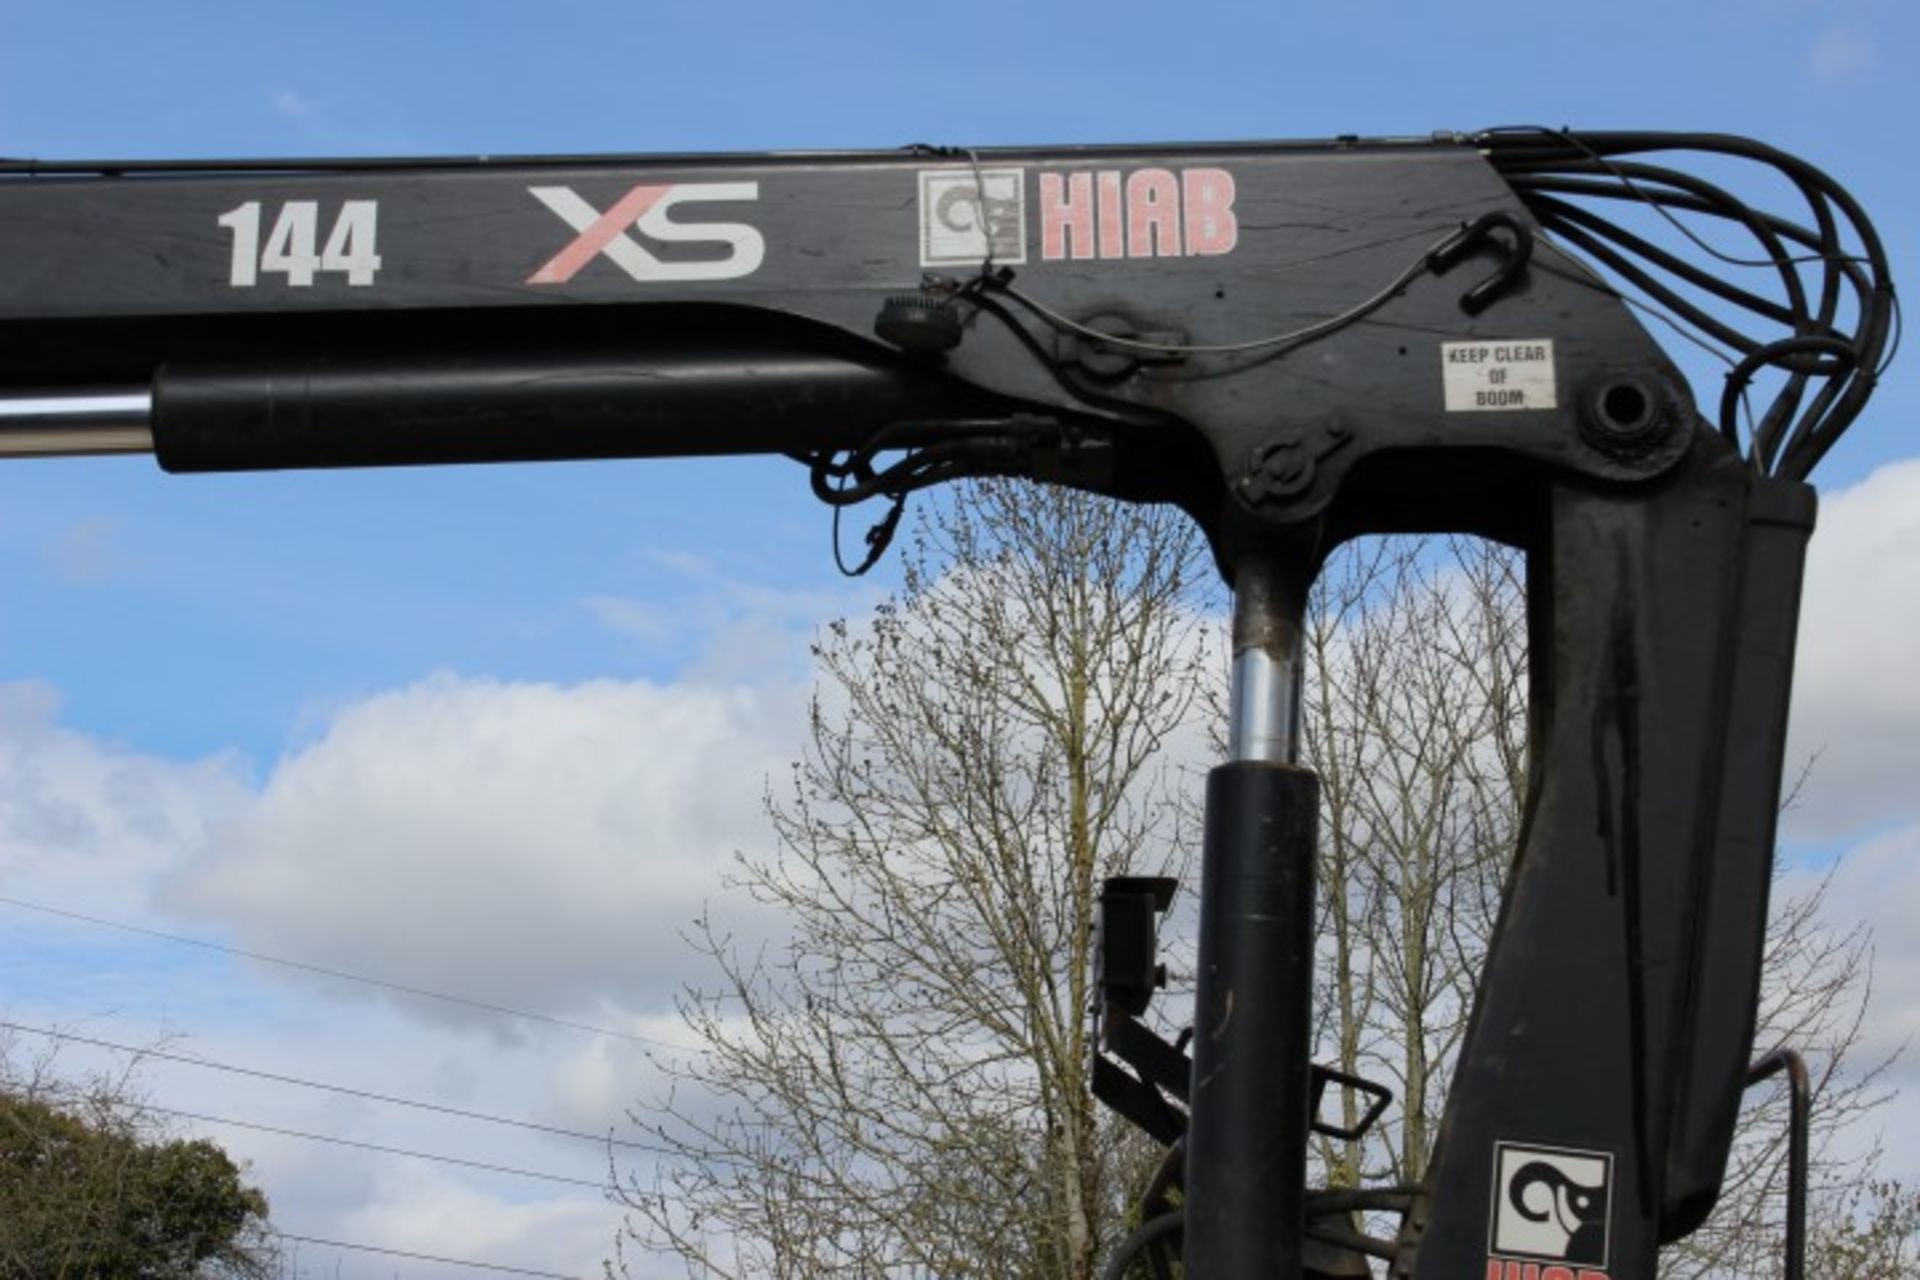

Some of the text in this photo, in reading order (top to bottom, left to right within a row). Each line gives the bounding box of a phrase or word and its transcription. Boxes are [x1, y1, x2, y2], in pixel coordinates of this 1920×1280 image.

[525, 181, 765, 284] XS
[1039, 168, 1238, 260] HIAB
[217, 200, 382, 287] 144
[1448, 345, 1546, 363] KEEP CLEAR
[1488, 367, 1507, 385] OF
[1476, 389, 1524, 406] BOOM
